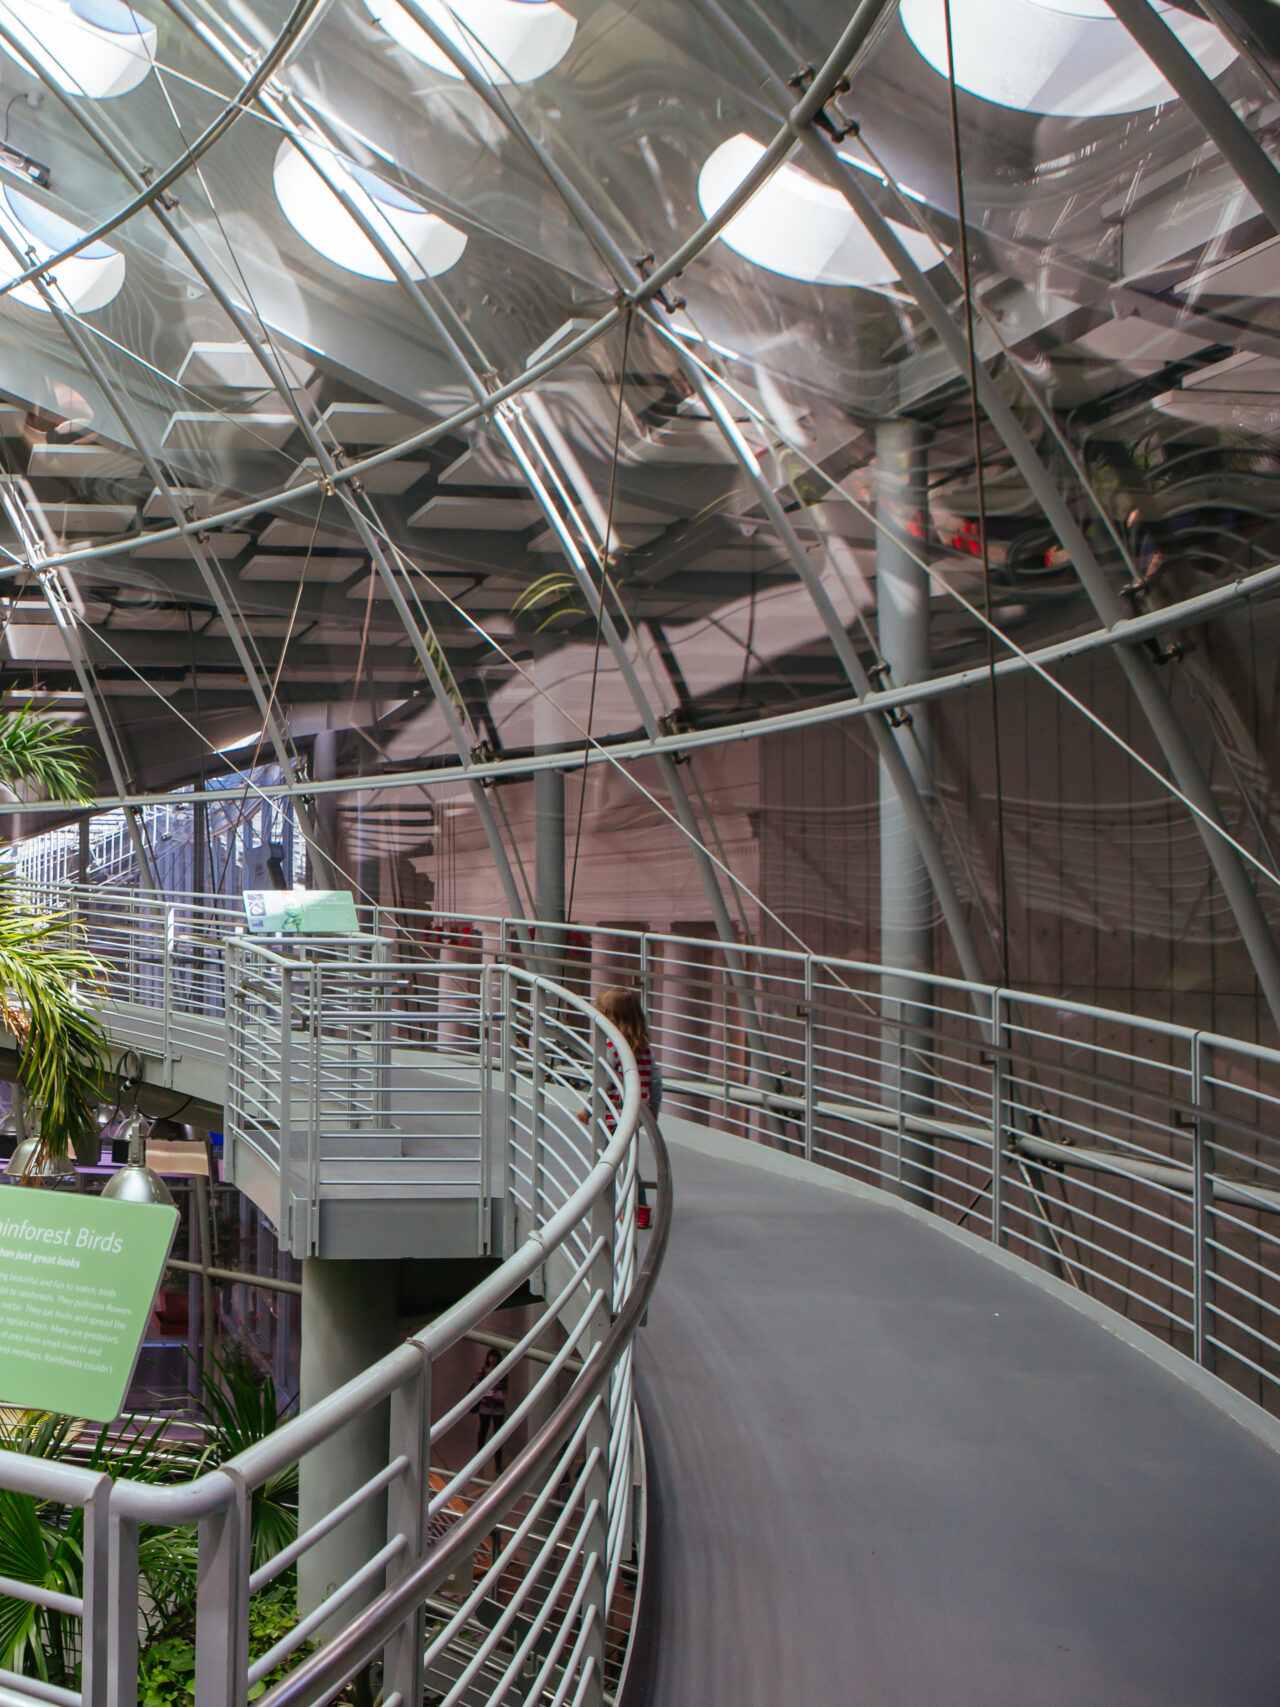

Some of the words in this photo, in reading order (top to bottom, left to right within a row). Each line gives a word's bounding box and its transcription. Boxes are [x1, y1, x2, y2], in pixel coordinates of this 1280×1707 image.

[75, 1227, 123, 1253] Birds
[15, 1249, 32, 1261] just
[32, 1253, 56, 1264] great
[57, 1256, 80, 1269] looks
